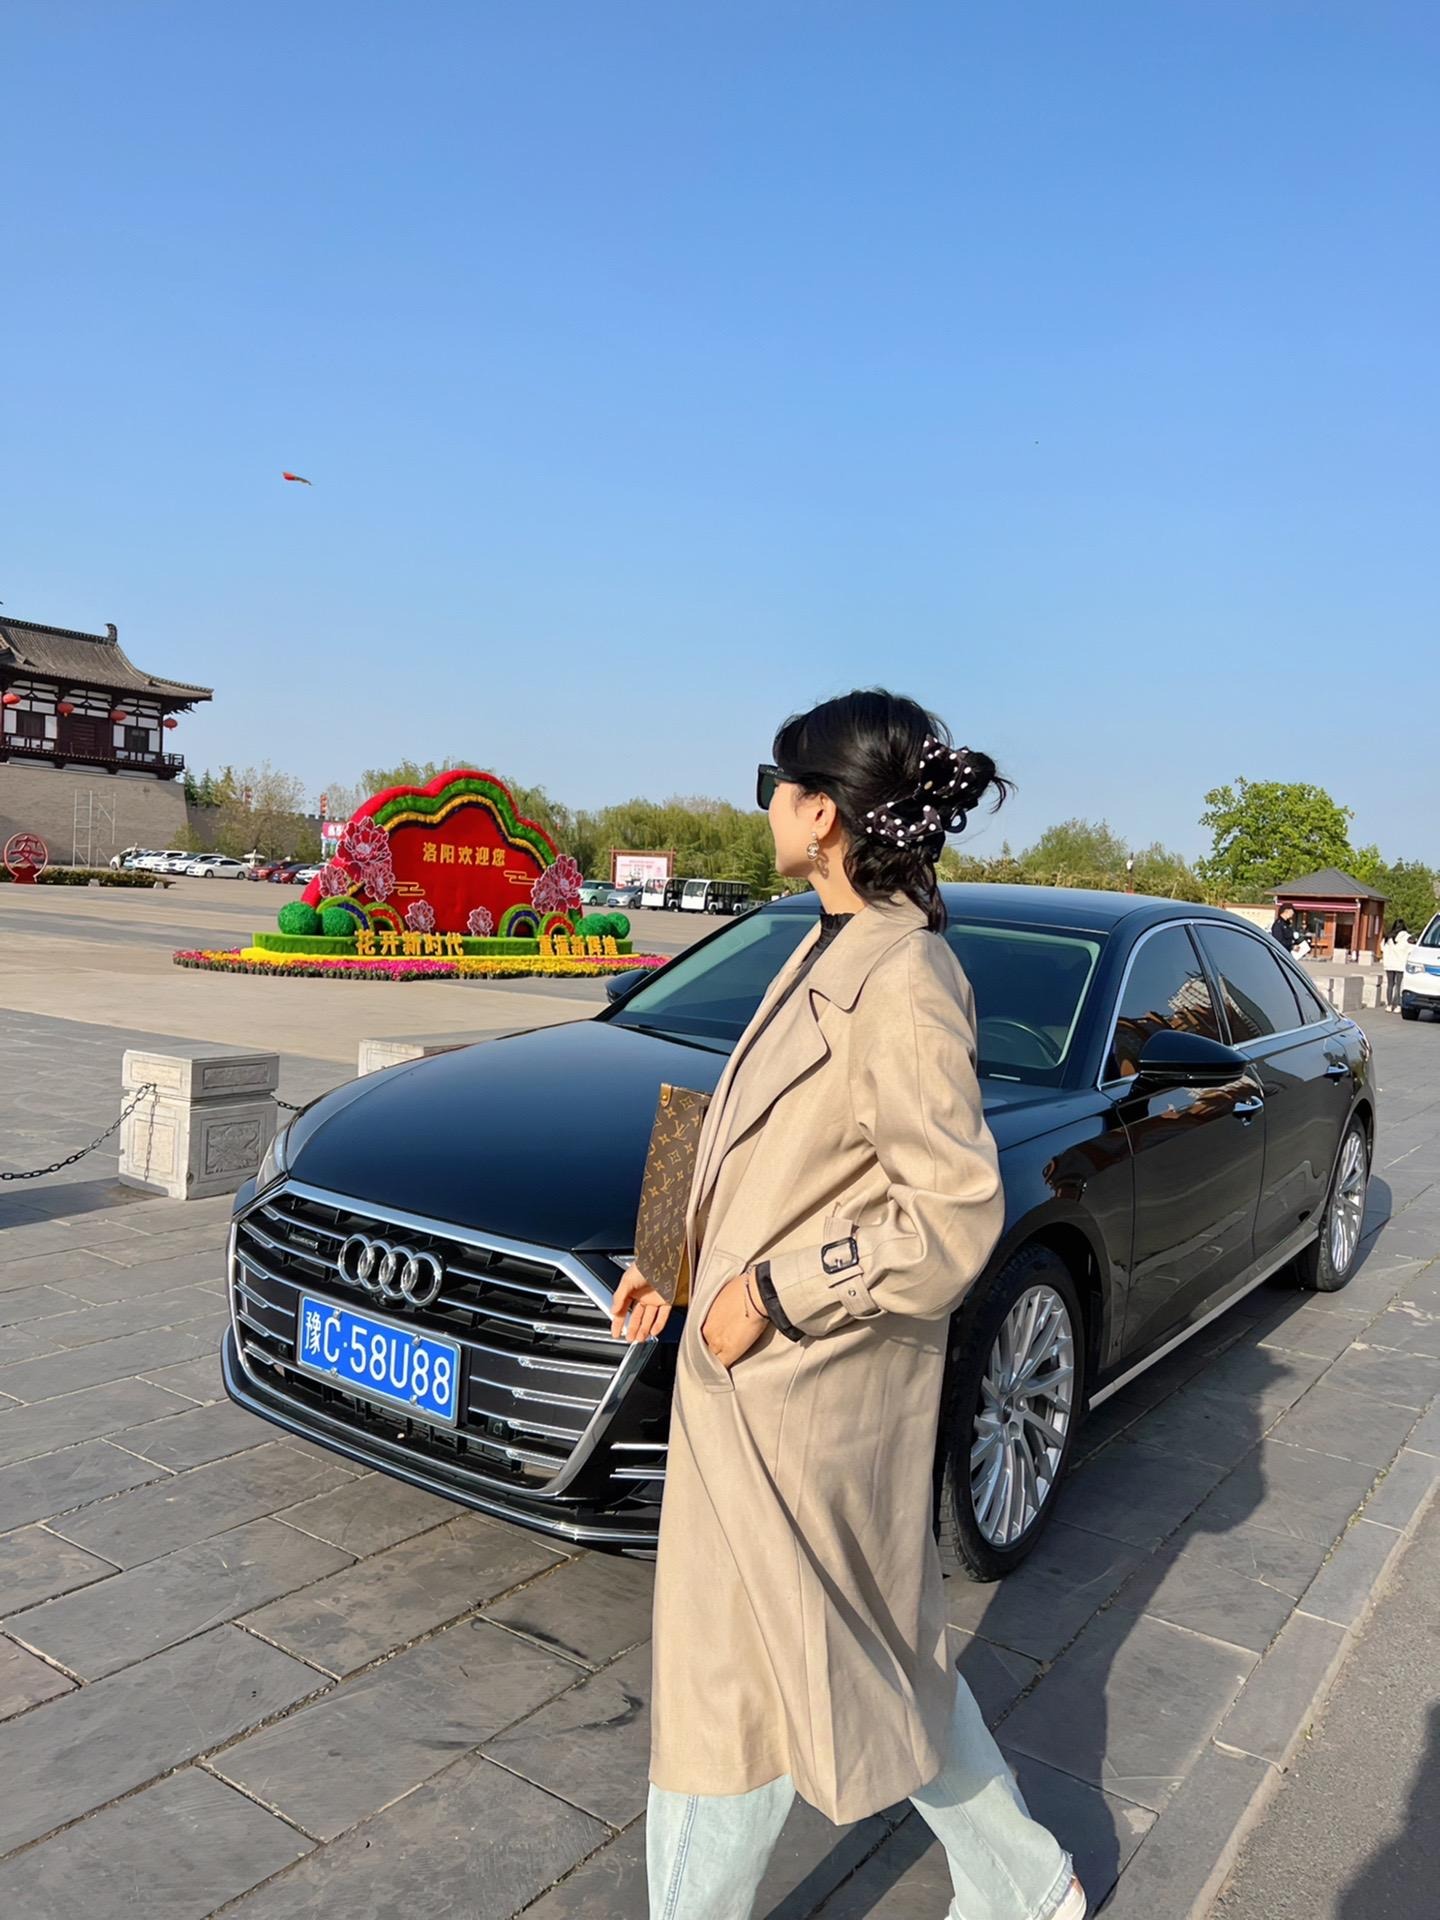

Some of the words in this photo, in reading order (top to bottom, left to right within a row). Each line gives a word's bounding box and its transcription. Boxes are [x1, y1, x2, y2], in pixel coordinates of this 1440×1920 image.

[423, 842, 505, 866] 洛阳欢迎您
[354, 929, 464, 956] 花开新时代
